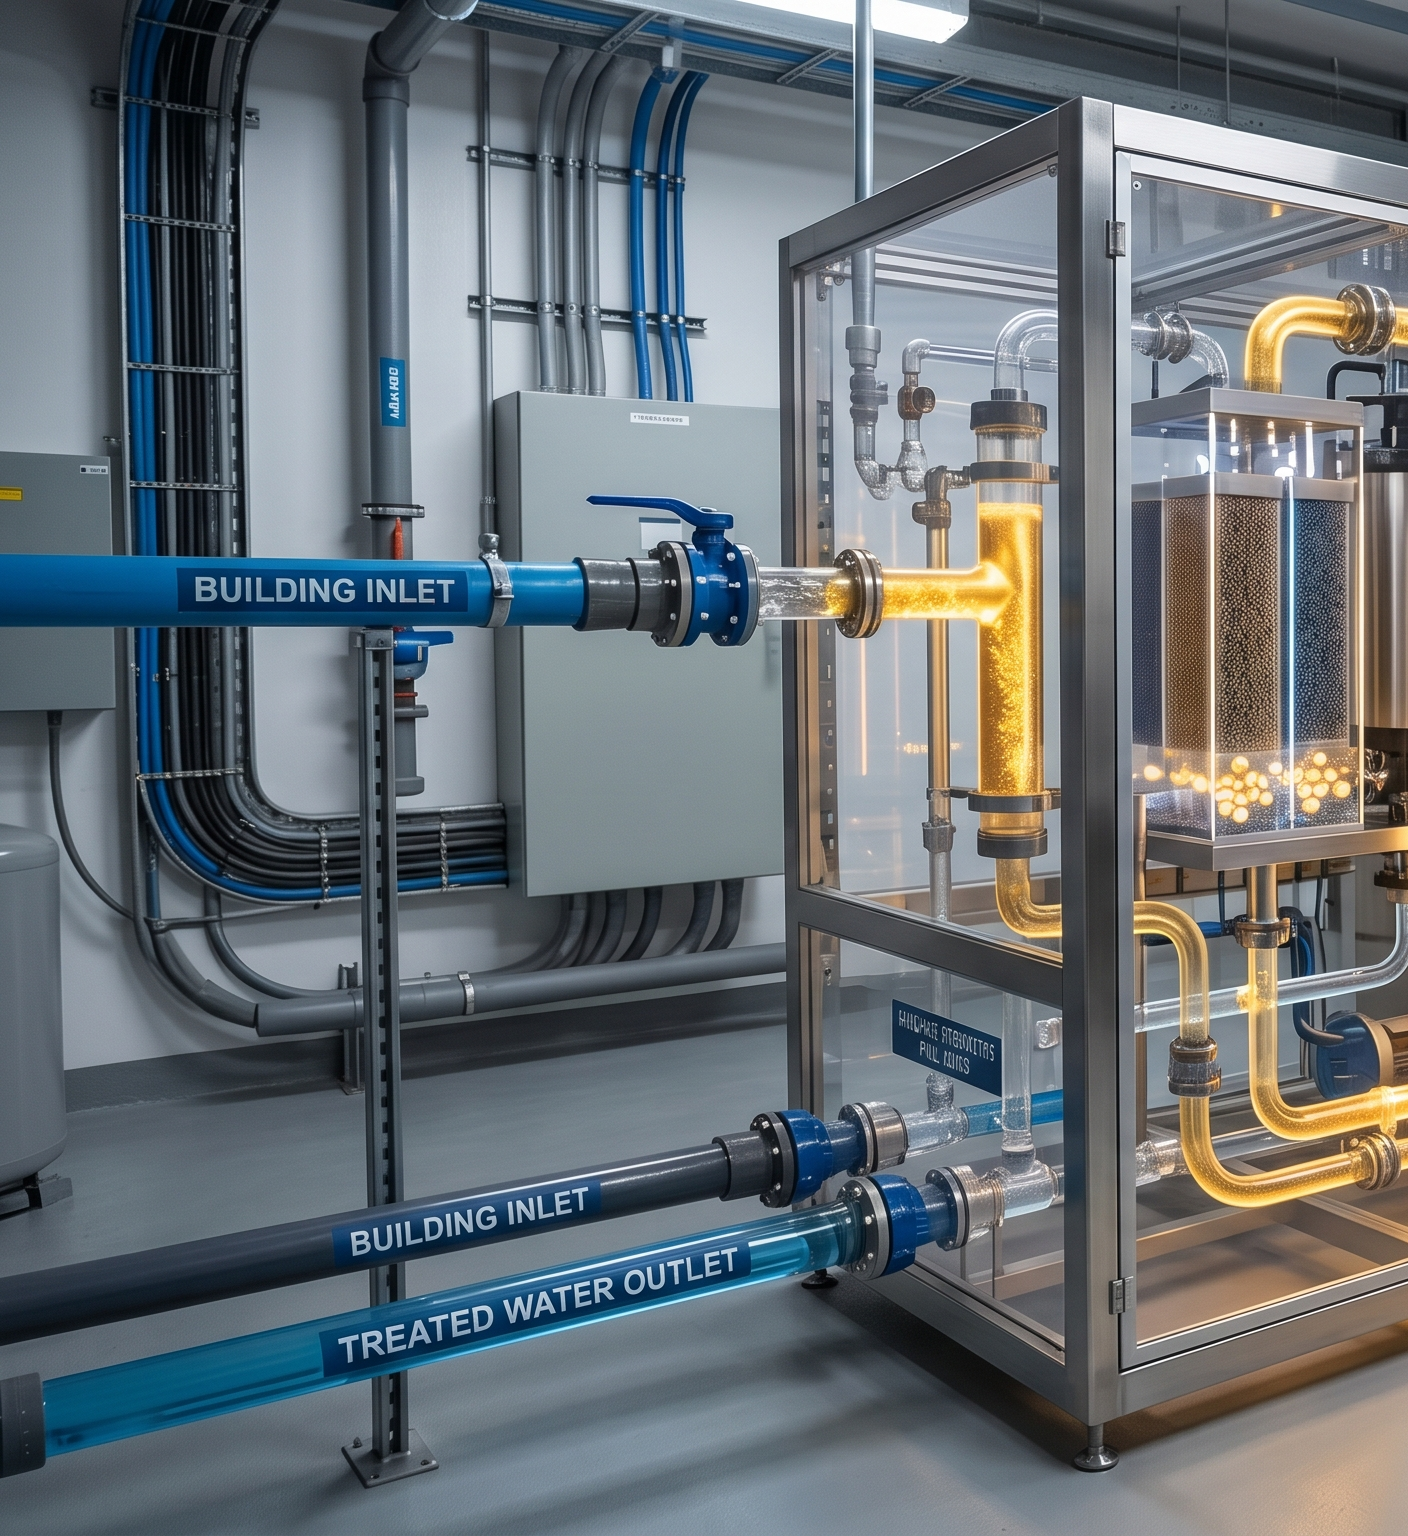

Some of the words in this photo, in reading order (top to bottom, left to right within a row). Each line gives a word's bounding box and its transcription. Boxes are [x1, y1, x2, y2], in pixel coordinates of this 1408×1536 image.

[194, 576, 356, 603] BUILDING
[366, 578, 455, 604] INLET
[350, 1205, 498, 1257] BUILDING
[507, 1186, 589, 1226] INLET
[338, 1304, 495, 1364] TREATED
[503, 1276, 615, 1325] WATER
[623, 1247, 739, 1296] OUTLET
